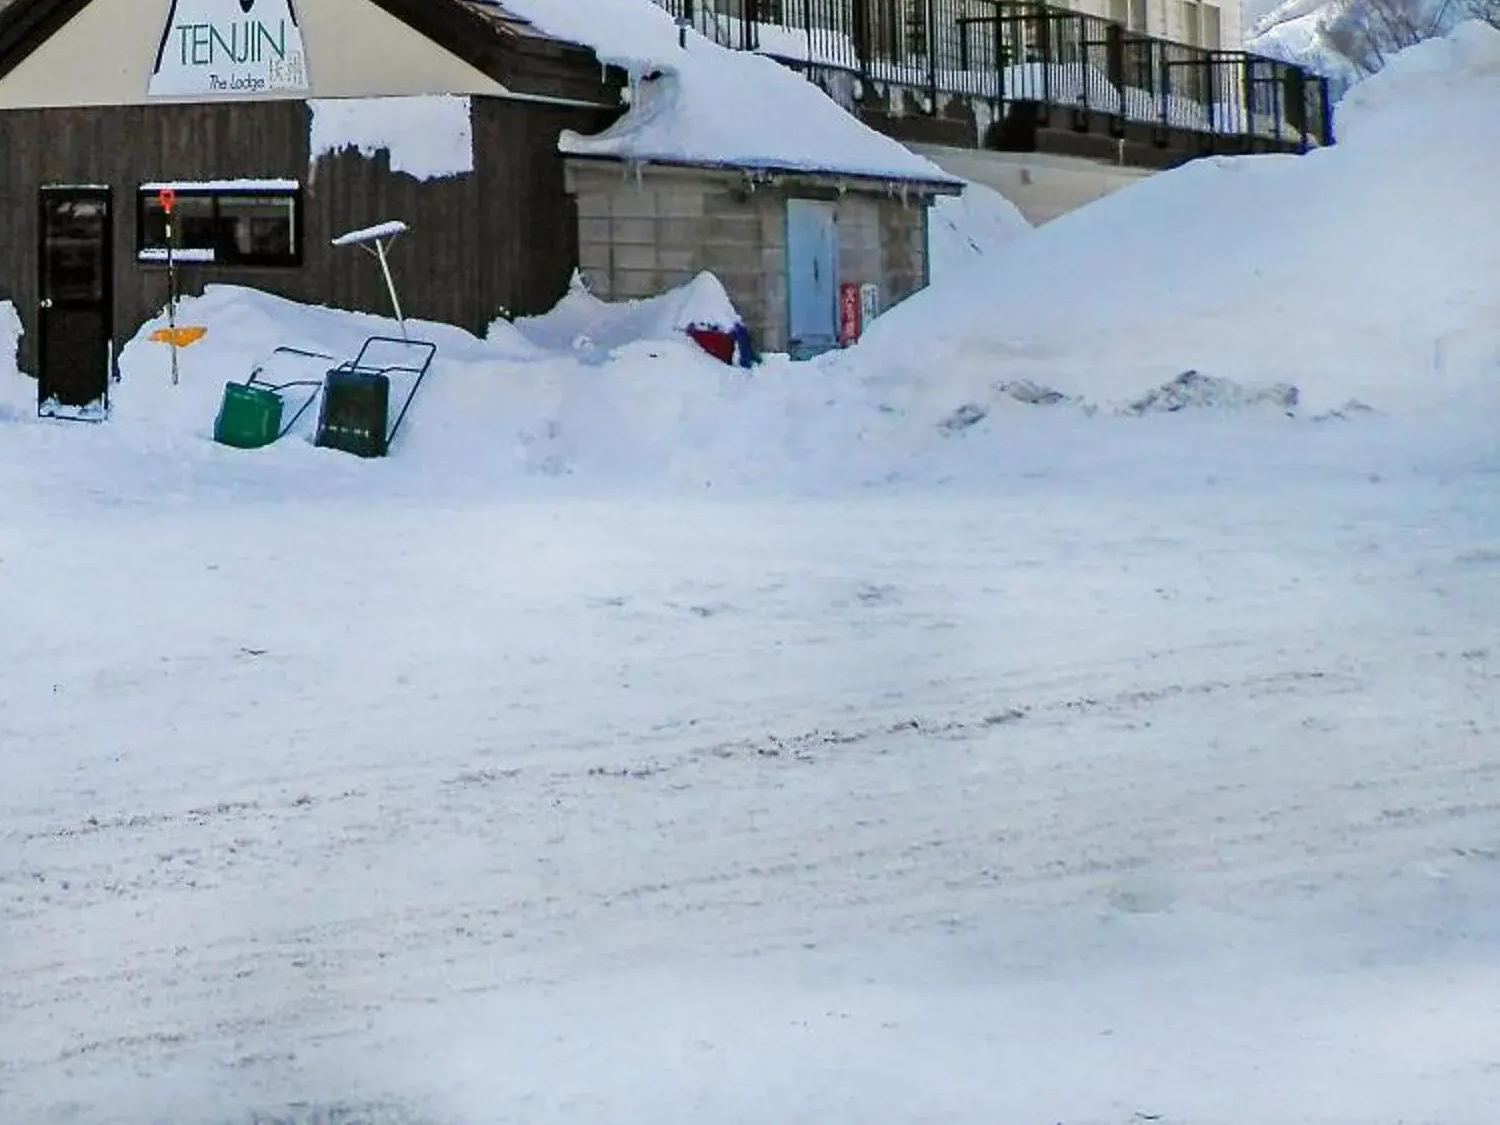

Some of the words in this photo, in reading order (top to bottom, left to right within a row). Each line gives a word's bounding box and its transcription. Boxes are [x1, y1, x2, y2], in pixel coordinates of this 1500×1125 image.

[176, 19, 285, 65] TENJIN
[209, 75, 227, 90] The
[230, 73, 265, 92] Lodge
